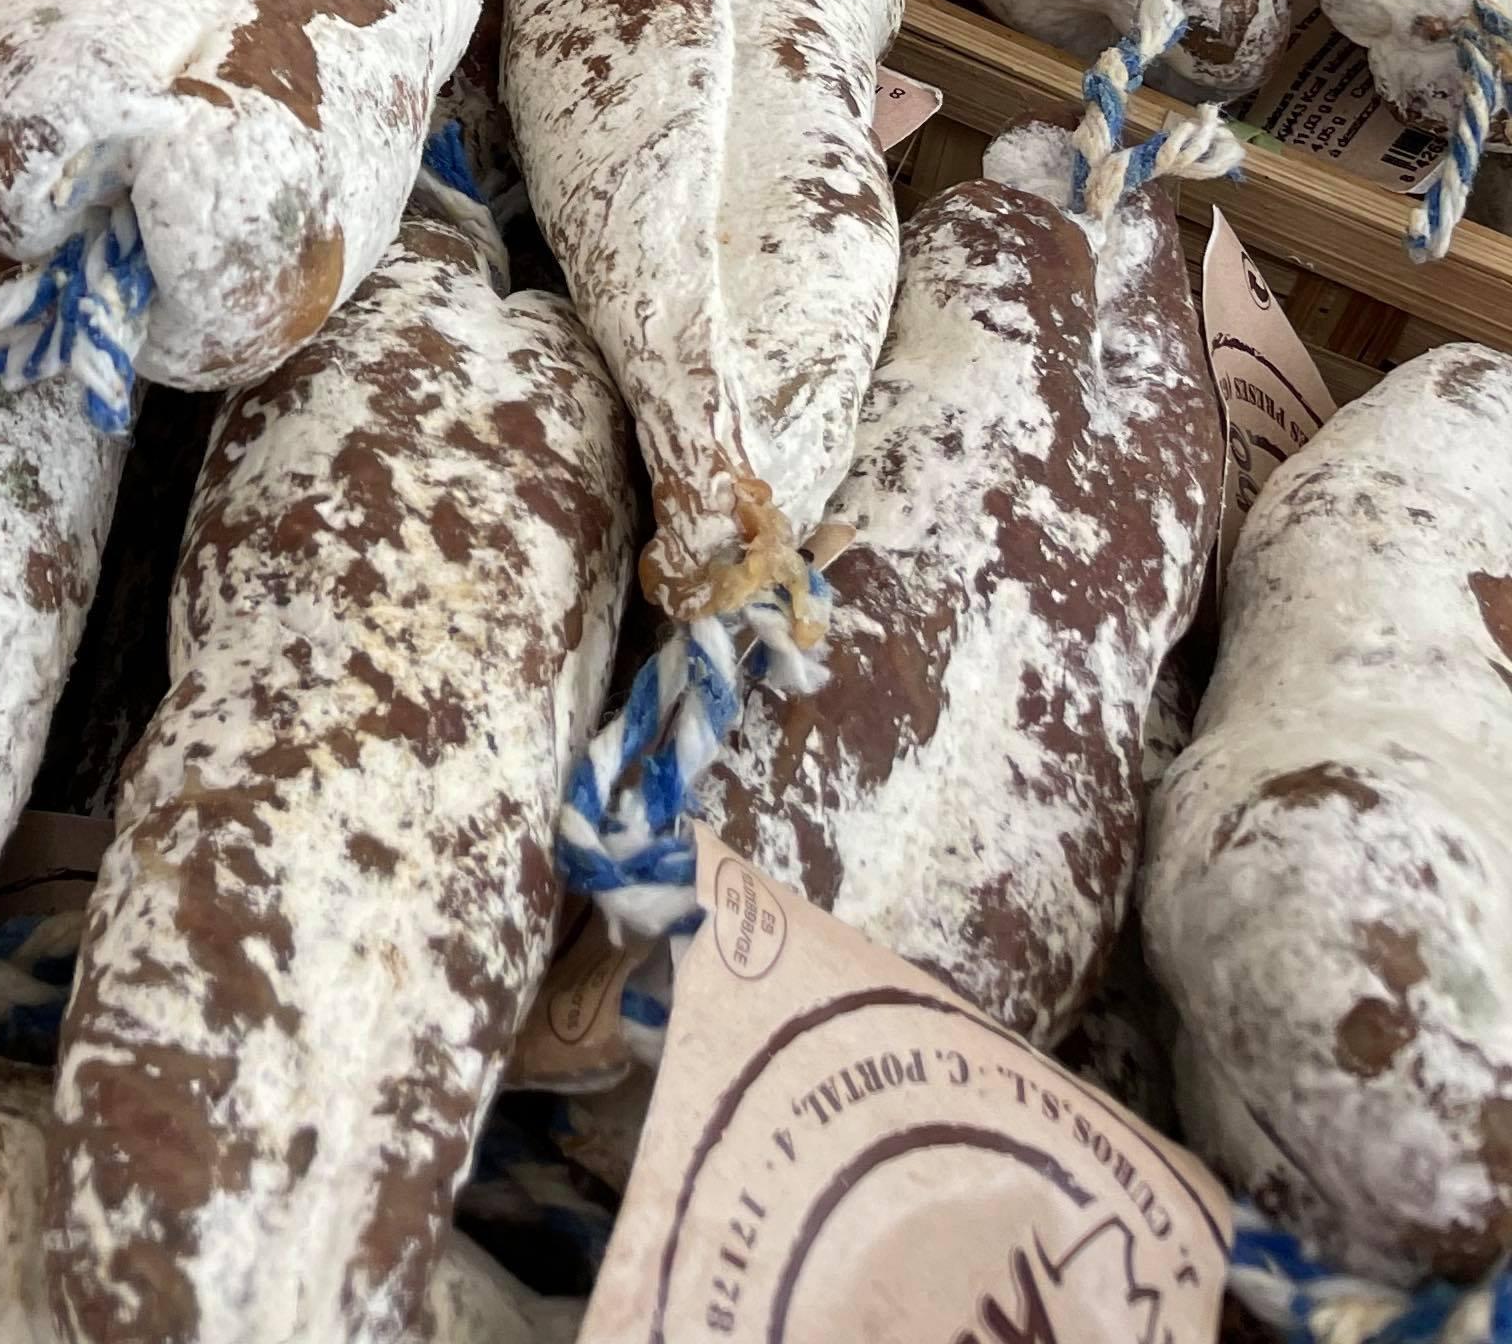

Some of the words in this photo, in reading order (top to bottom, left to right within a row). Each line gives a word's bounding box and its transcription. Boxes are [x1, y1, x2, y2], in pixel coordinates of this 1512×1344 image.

[1233, 376, 1286, 429] PRESES
[790, 1047, 930, 1127] PORTAL,
[934, 1050, 970, 1084] C.
[771, 1128, 800, 1165] 4
[706, 1184, 769, 1335] 17178
[1174, 1246, 1199, 1289] J.
